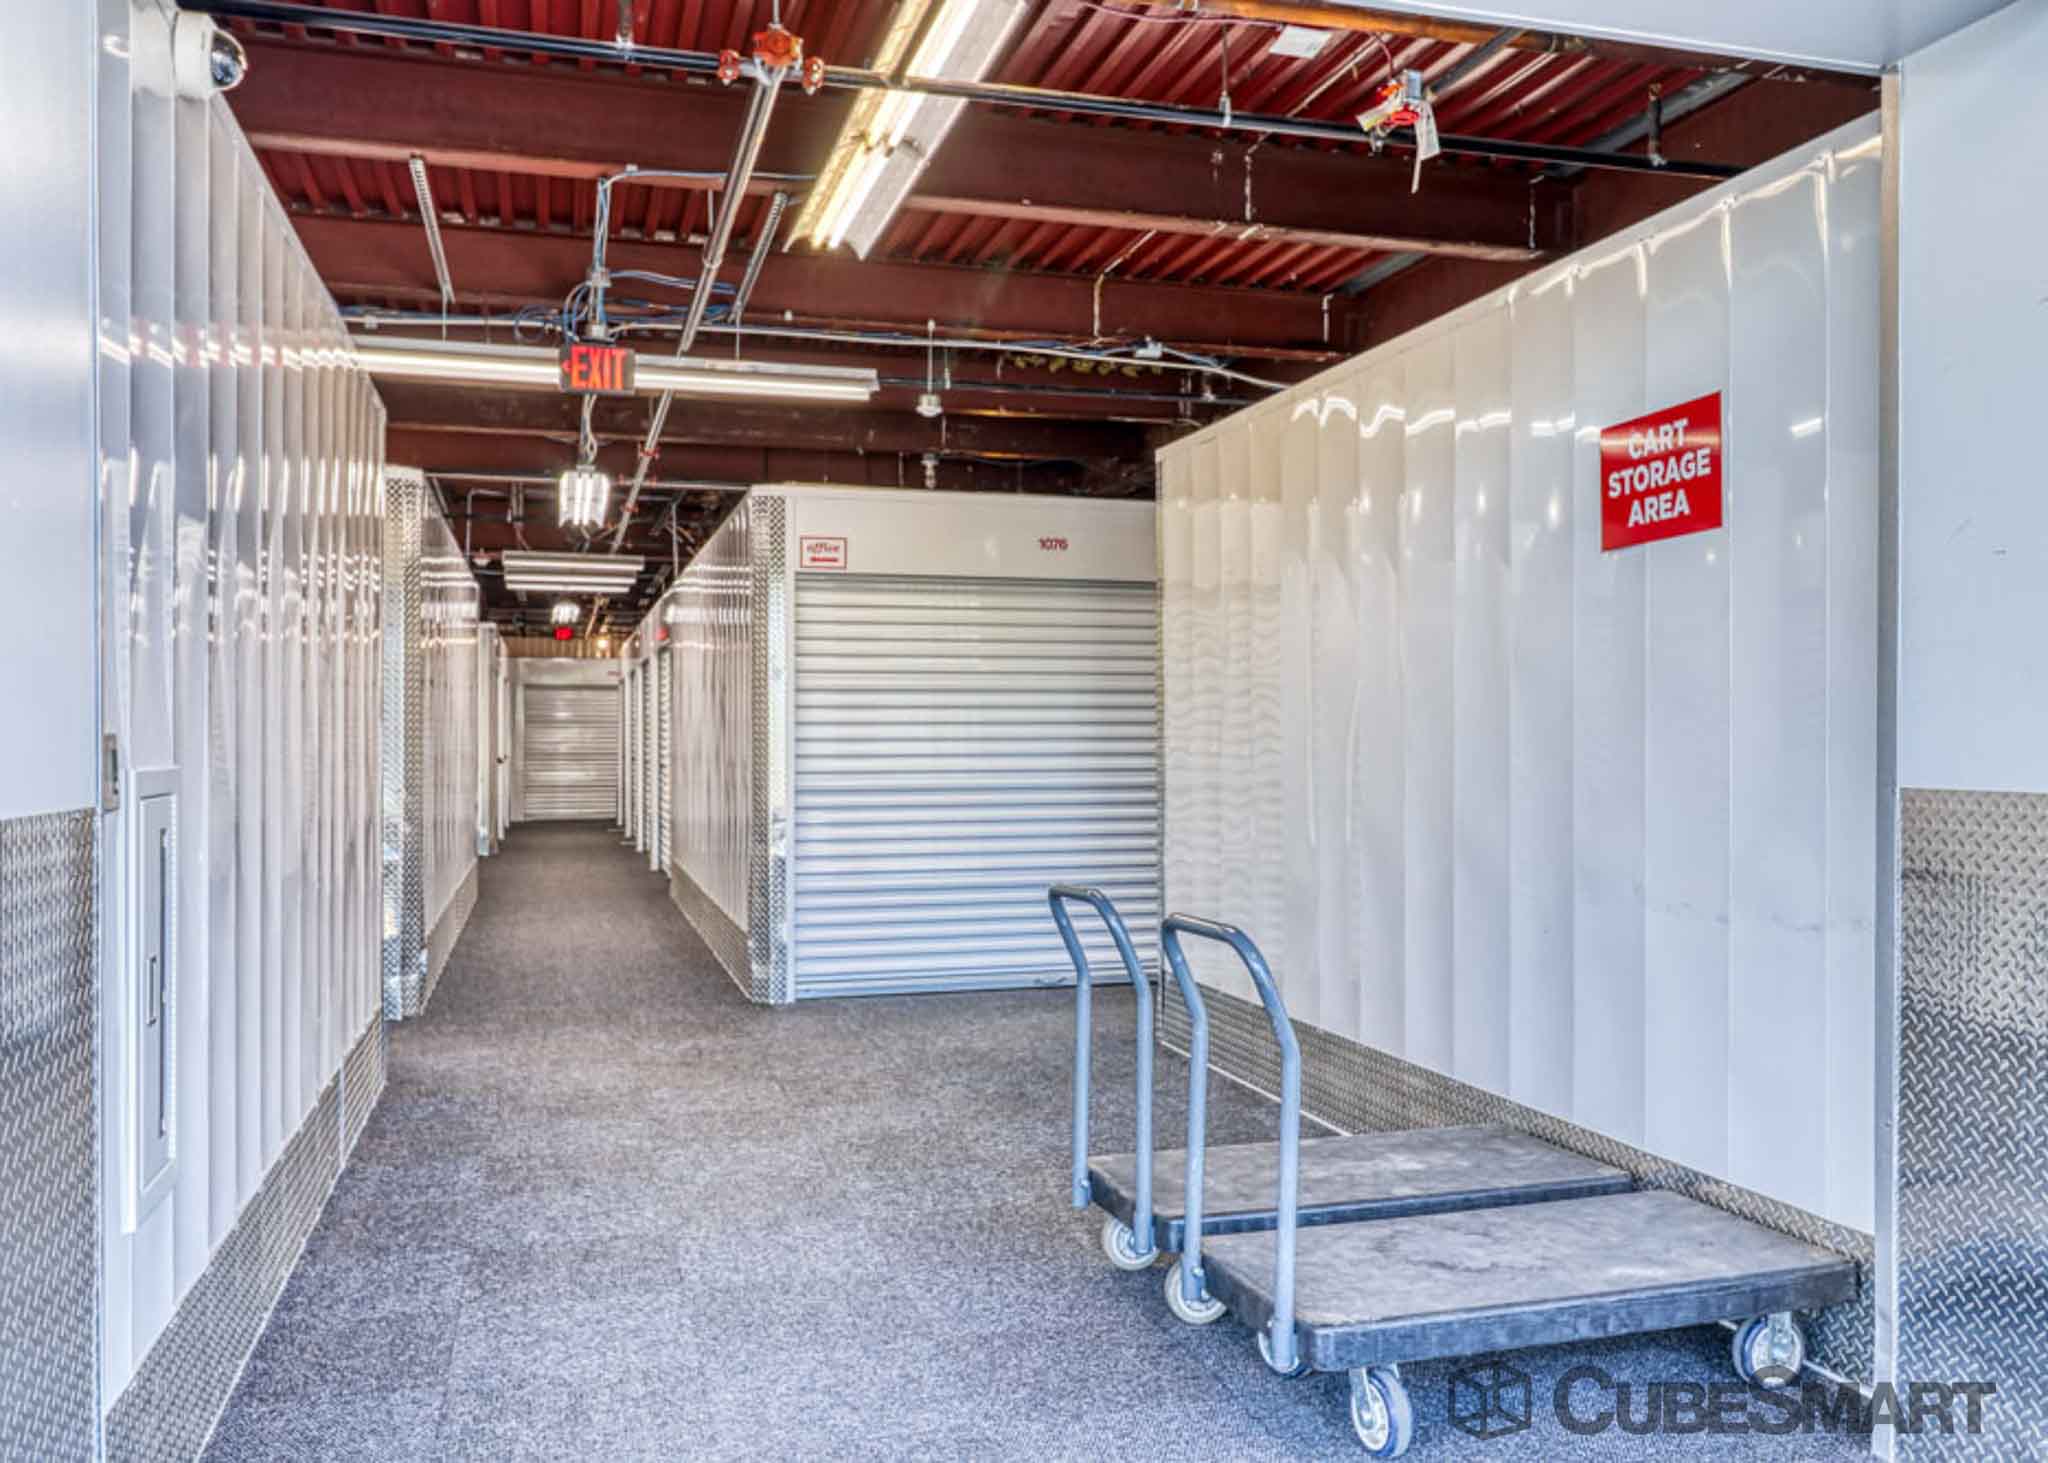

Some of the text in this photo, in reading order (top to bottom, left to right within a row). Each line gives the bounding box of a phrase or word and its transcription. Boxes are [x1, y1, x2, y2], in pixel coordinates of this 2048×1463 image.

[571, 345, 627, 390] EXIT
[1628, 417, 1688, 459] CART
[1608, 447, 1711, 498] STORAGE
[1628, 488, 1690, 528] AREA
